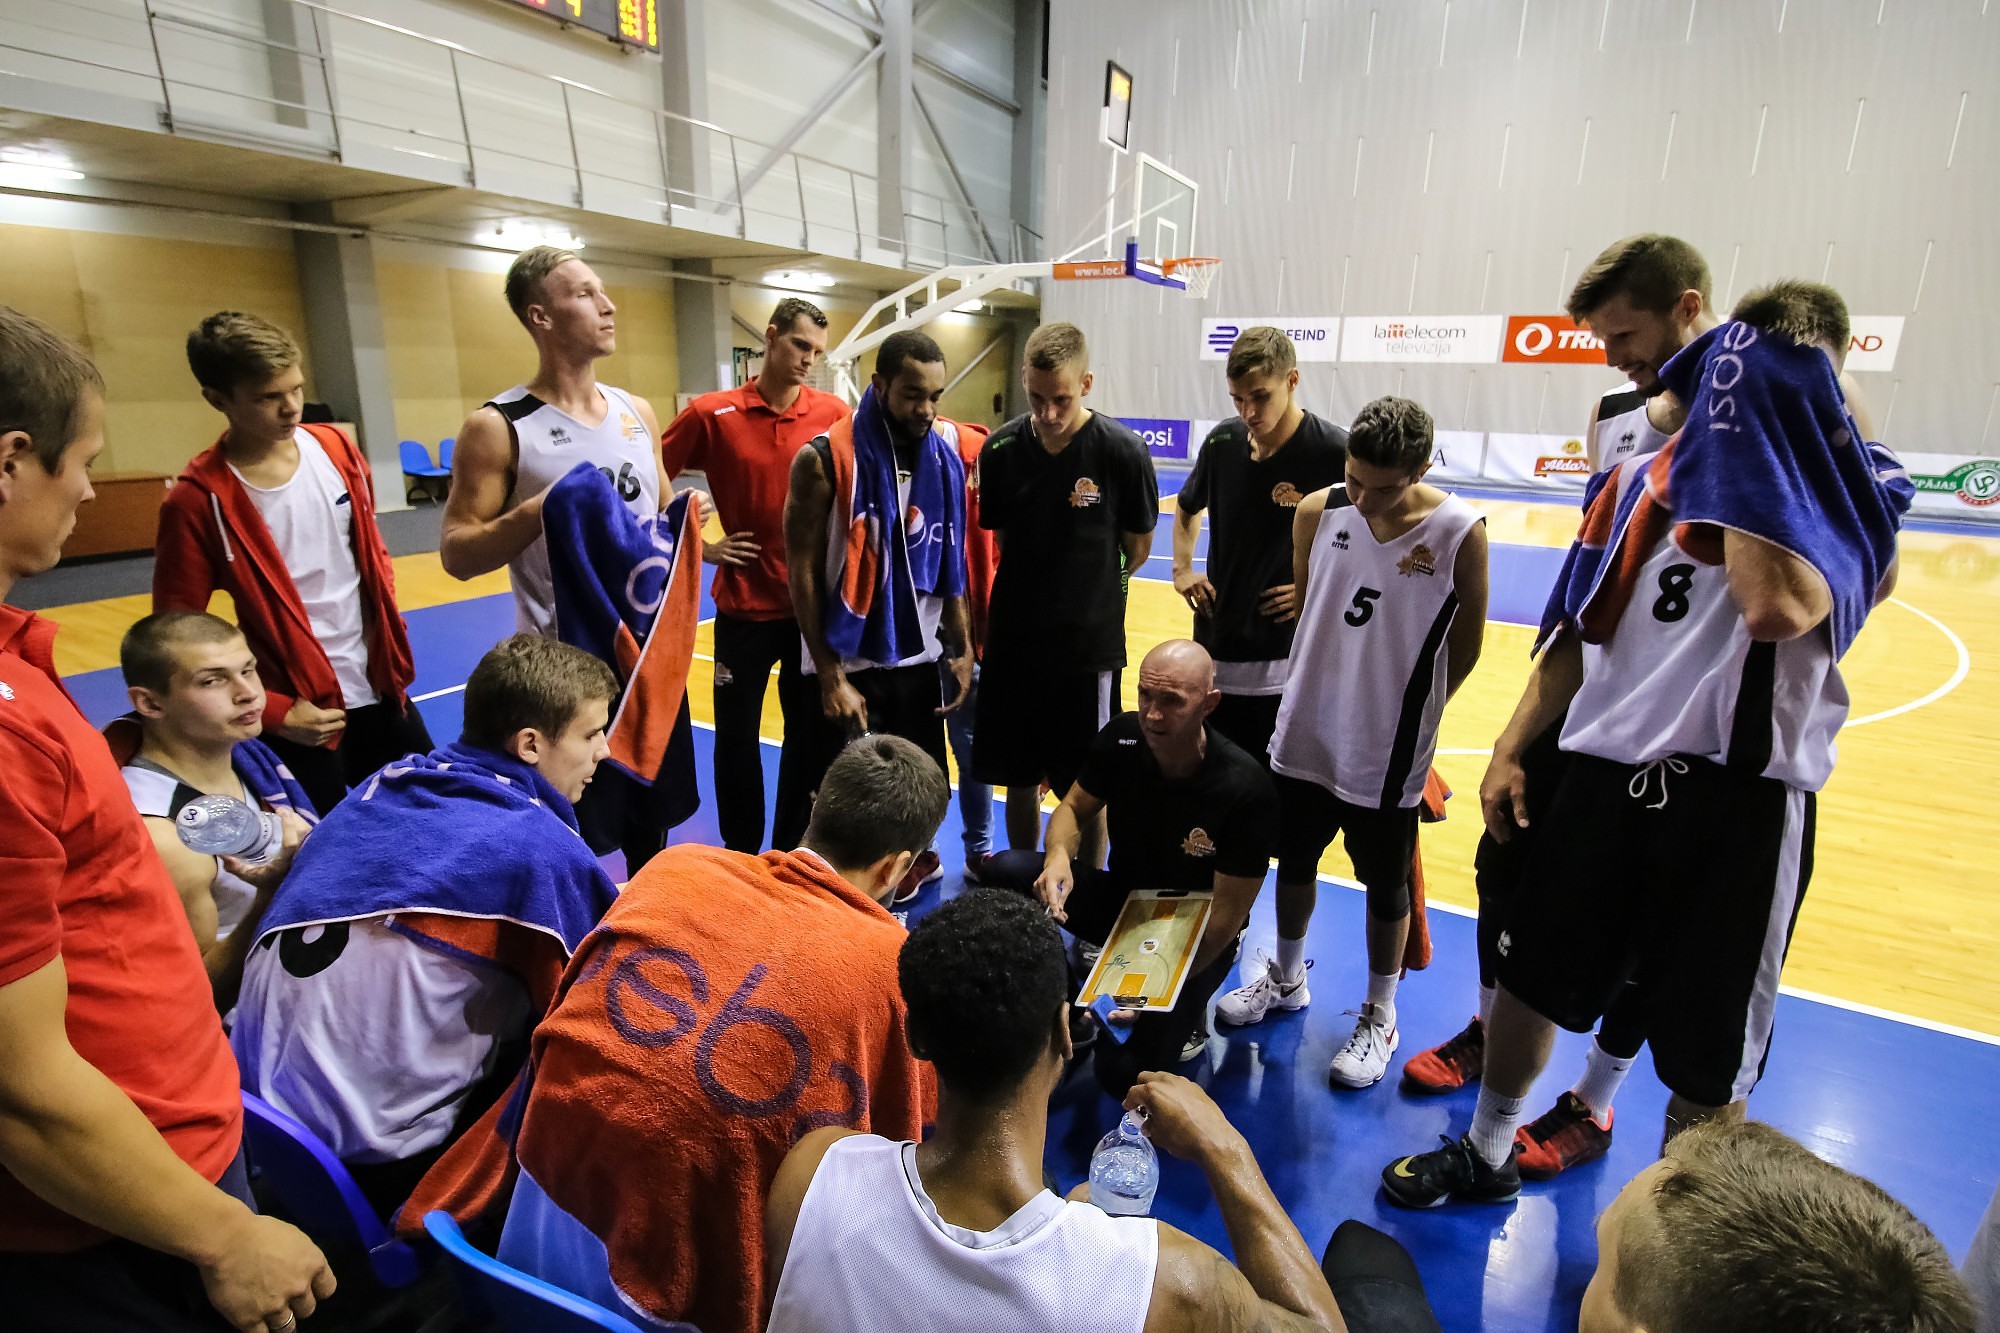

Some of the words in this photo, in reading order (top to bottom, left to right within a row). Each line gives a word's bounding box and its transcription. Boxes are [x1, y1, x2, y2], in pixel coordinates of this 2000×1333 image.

[1281, 329, 1326, 341] FEIND
[1557, 330, 1605, 349] TRI
[1848, 335, 1883, 351] ND
[1709, 321, 1758, 433] epsi
[1541, 460, 1590, 472] Aldar
[1652, 563, 1696, 623] 8
[1344, 586, 1382, 627] 5
